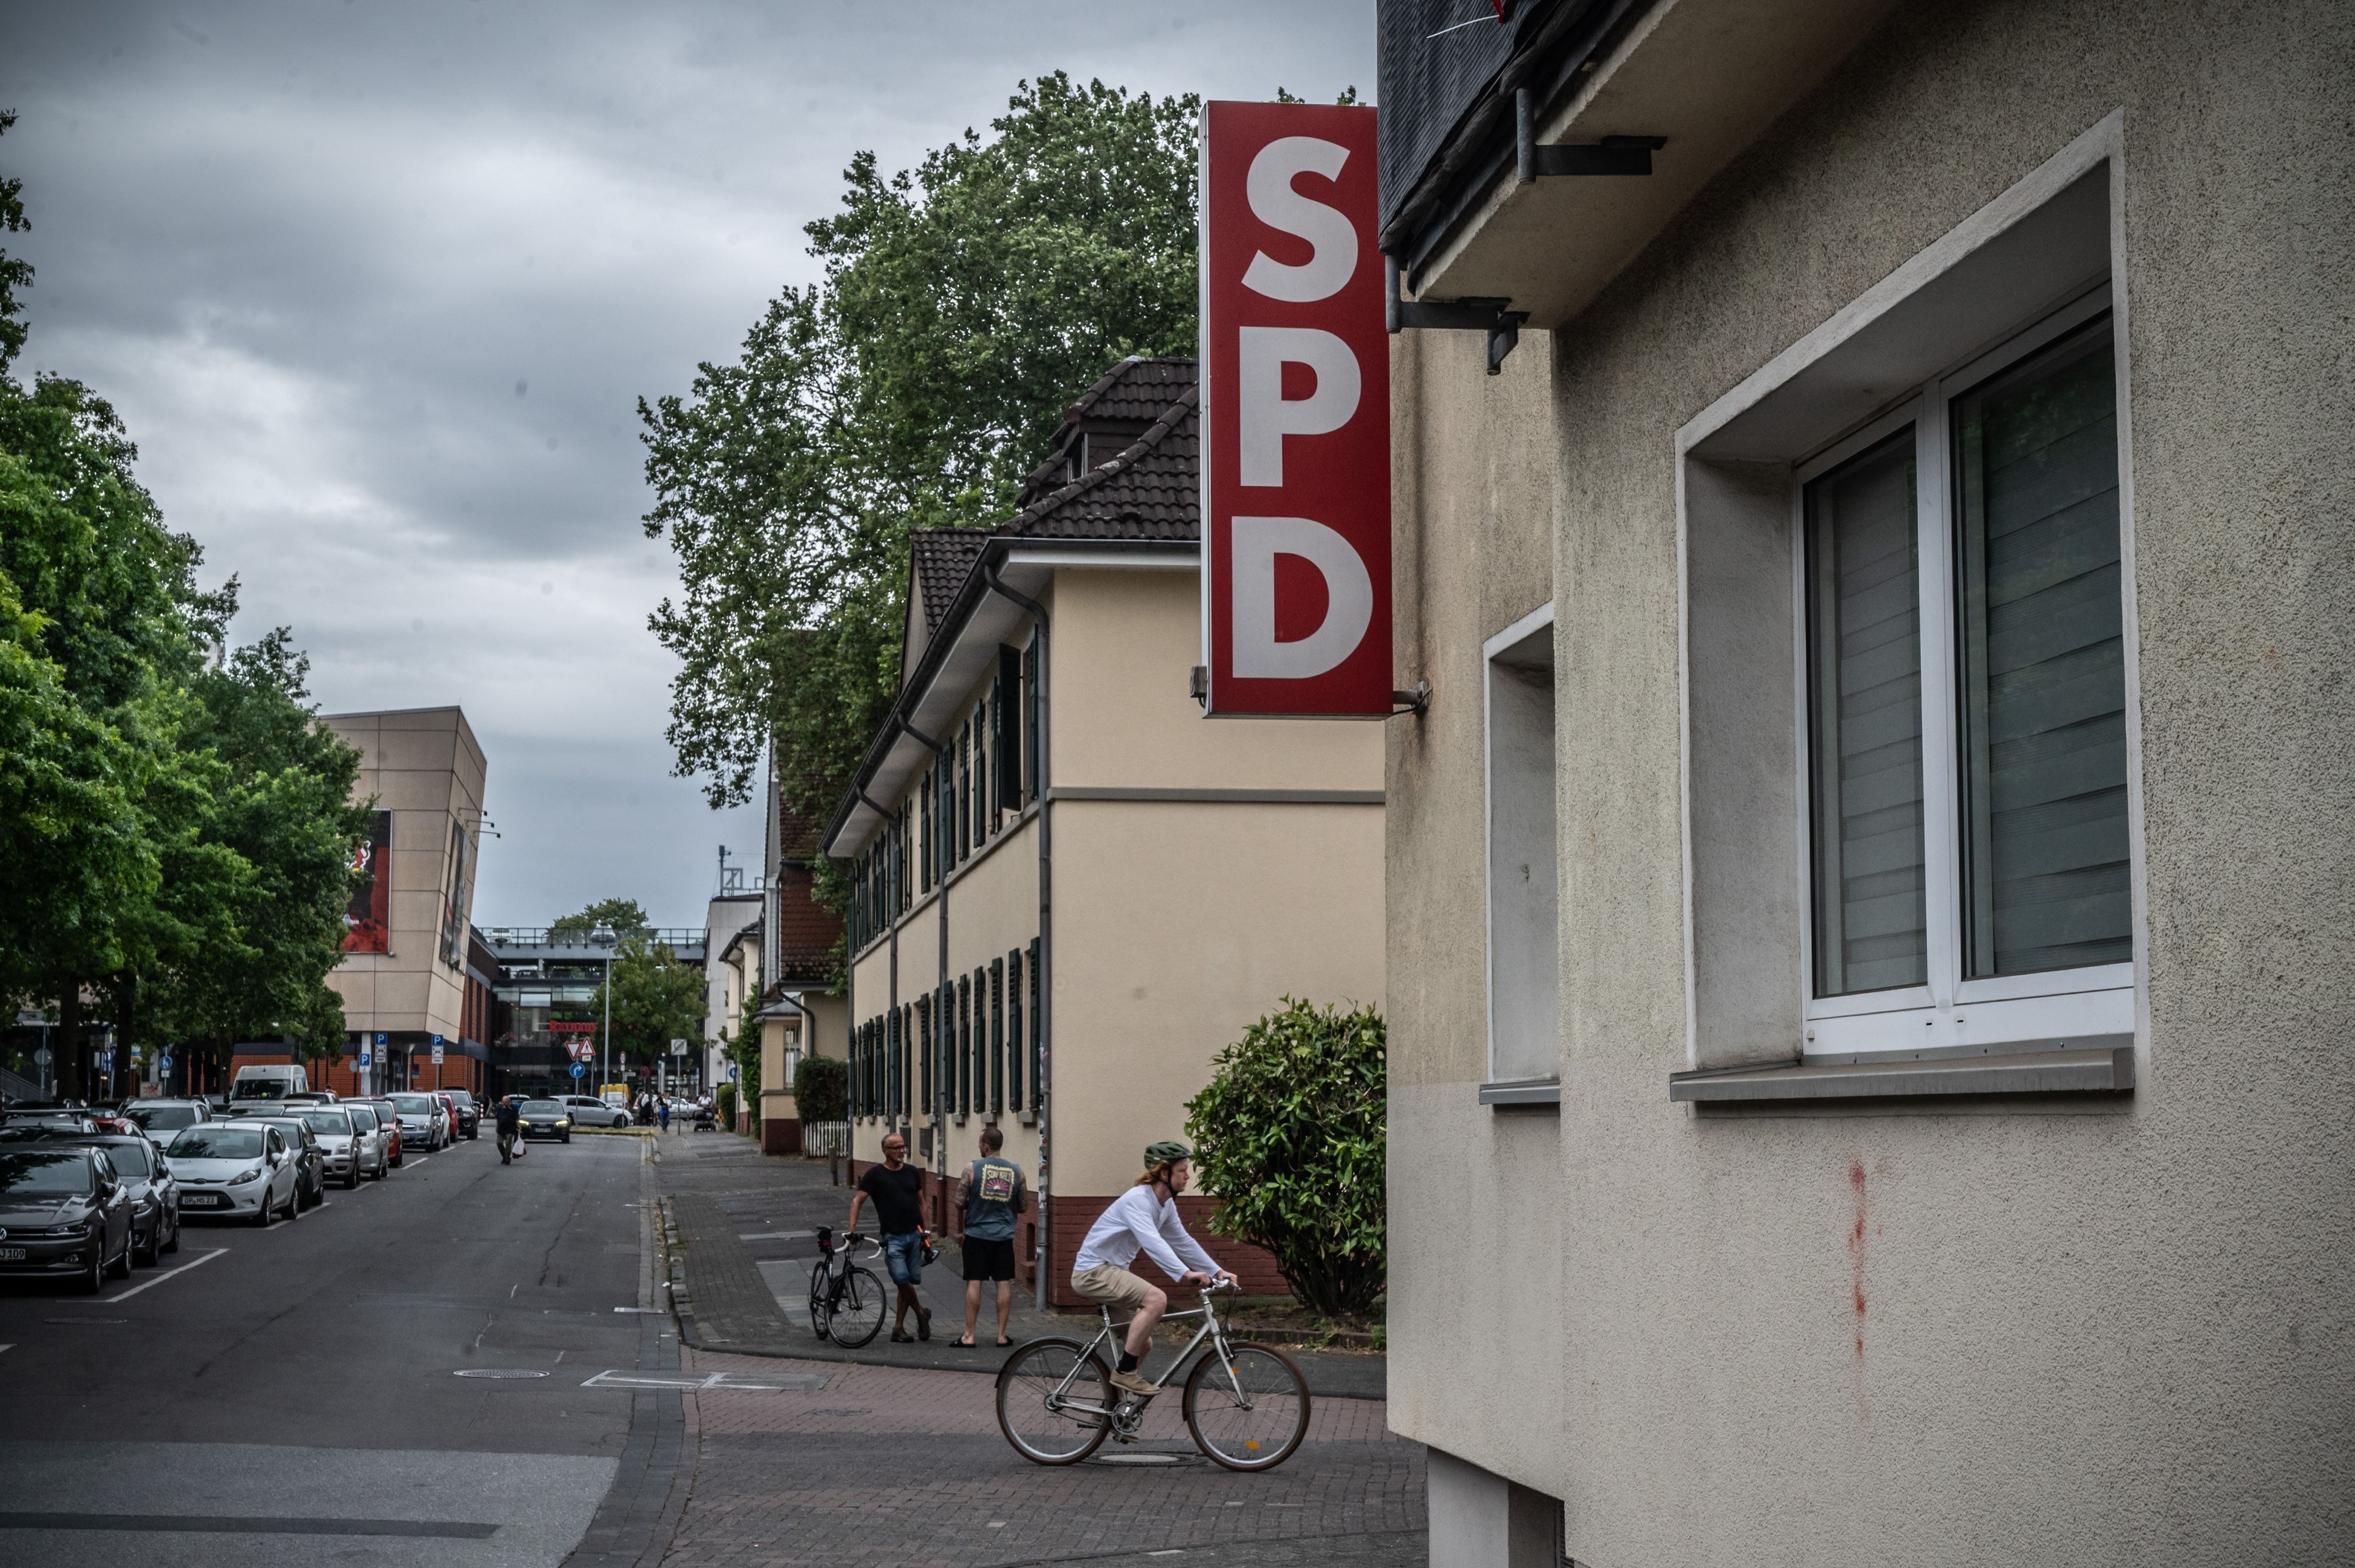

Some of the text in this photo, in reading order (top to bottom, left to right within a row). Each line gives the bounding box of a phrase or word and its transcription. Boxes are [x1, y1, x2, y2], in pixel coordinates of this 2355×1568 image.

[1231, 135, 1374, 679] SPD
[377, 1035, 384, 1044] P
[434, 1036, 441, 1045] P
[361, 1055, 368, 1064] P
[7, 1249, 25, 1258] 109
